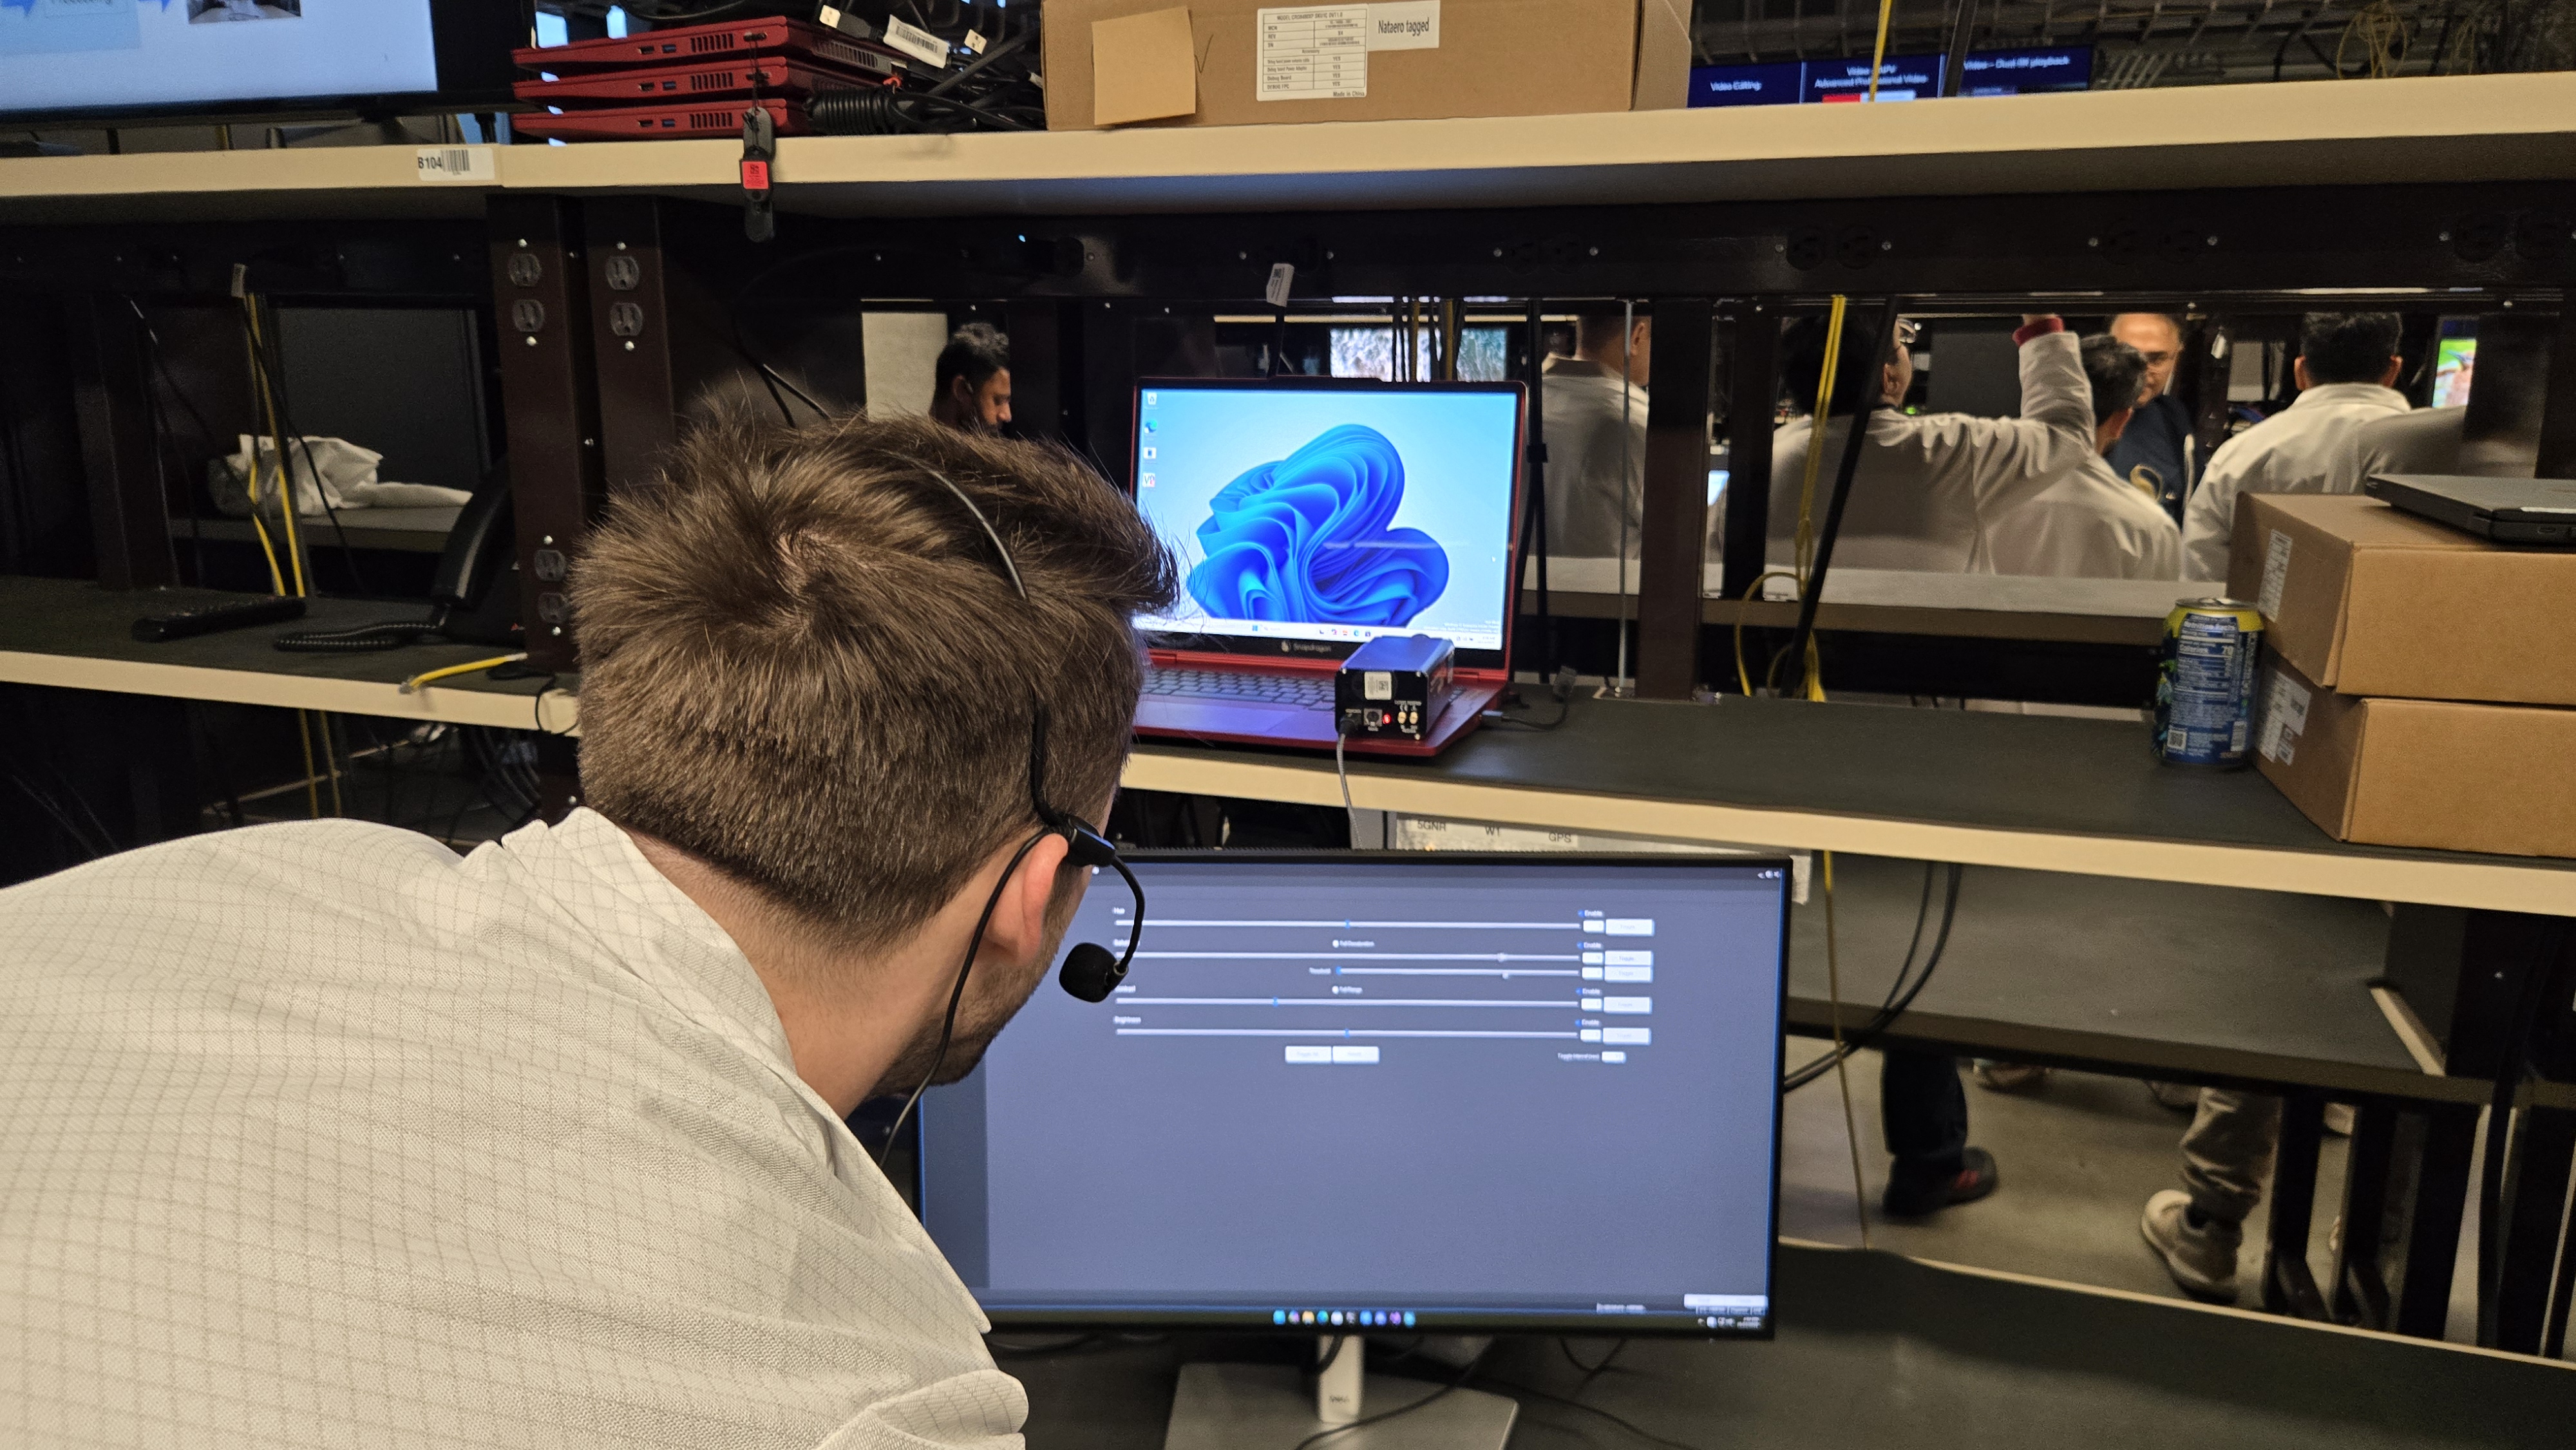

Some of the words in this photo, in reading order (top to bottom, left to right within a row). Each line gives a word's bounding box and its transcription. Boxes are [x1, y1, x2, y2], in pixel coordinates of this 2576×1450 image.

[1378, 20, 1404, 33] Nataero
[1406, 17, 1430, 36] tagged
[1710, 81, 1732, 91] Video
[1733, 80, 1763, 91] Editing
[417, 157, 448, 169] B104
[1548, 833, 1572, 843] GPS
